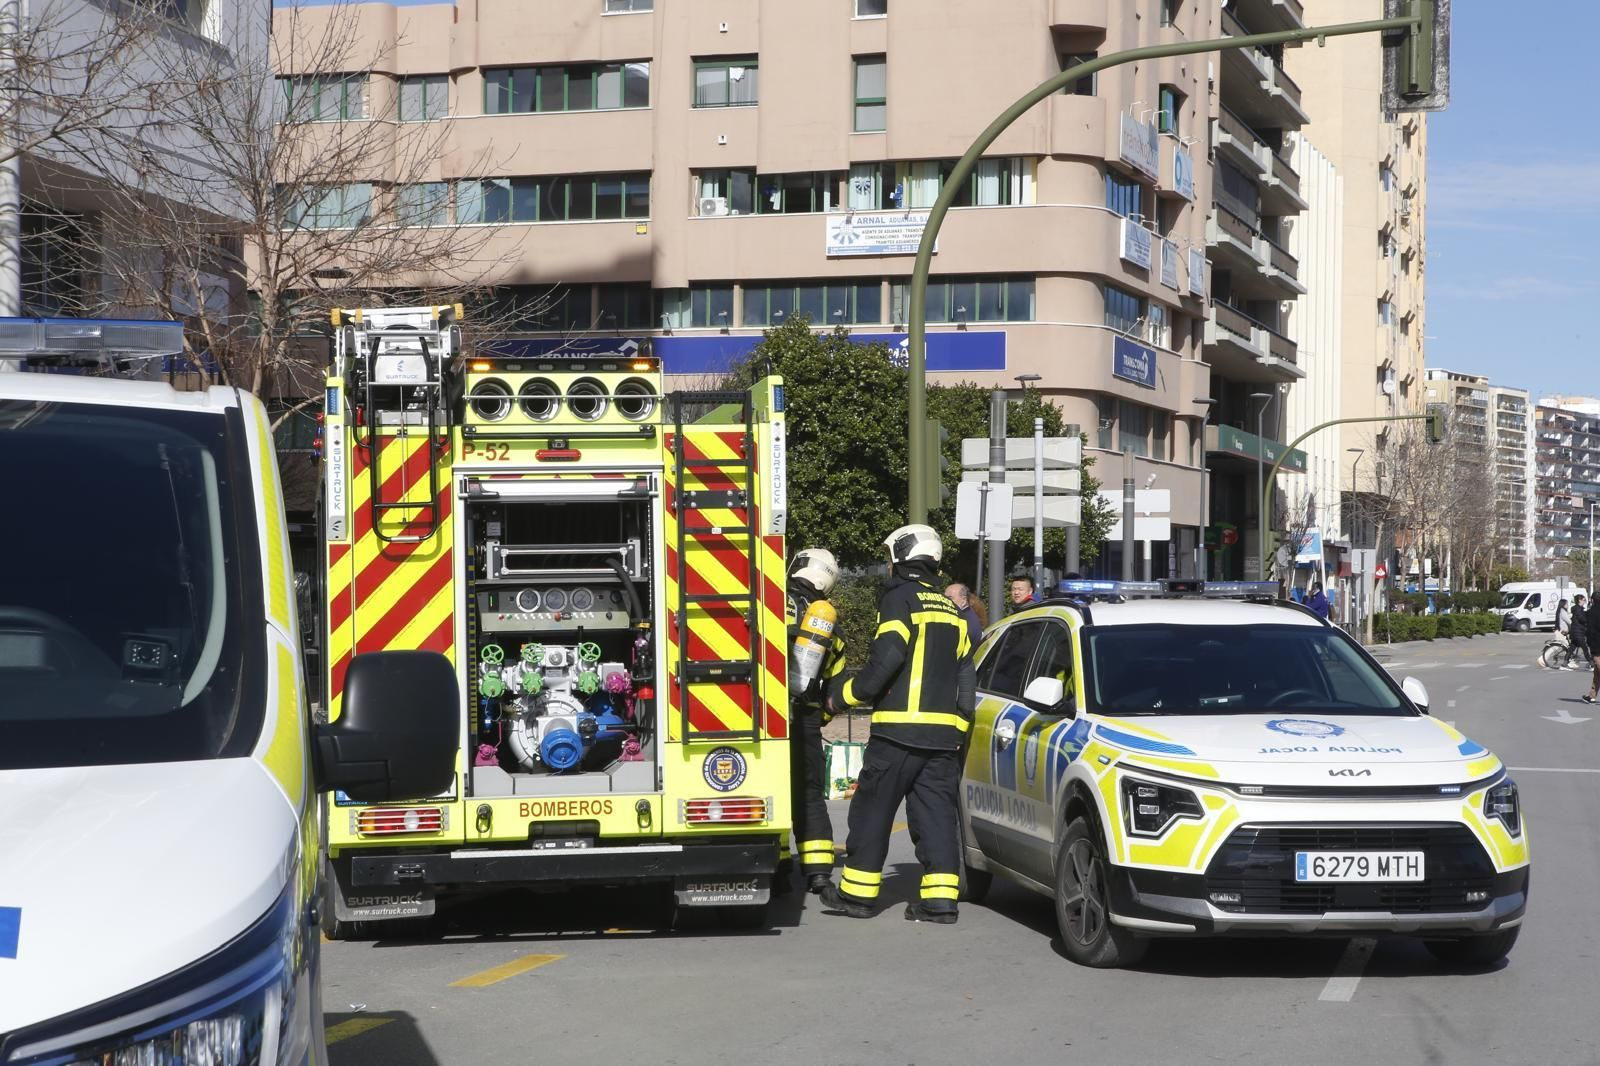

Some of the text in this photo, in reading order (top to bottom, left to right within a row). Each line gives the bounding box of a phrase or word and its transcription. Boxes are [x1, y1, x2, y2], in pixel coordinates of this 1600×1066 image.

[856, 217, 886, 225] ARNAL
[462, 442, 510, 461] P-52
[333, 447, 342, 510] SURTRUCK
[773, 444, 781, 505] SURTRUCK
[1328, 769, 1372, 777] KIA
[519, 800, 613, 817] BOMBEROS
[966, 783, 1038, 832] POLICIA LOCAL
[1313, 856, 1418, 877] 6279 MTH
[686, 882, 752, 893] SURTRUCK
[347, 895, 416, 906] SURTRUCK
[691, 893, 754, 902] www.surtruck.com
[352, 907, 418, 916] www.surtruck.com
